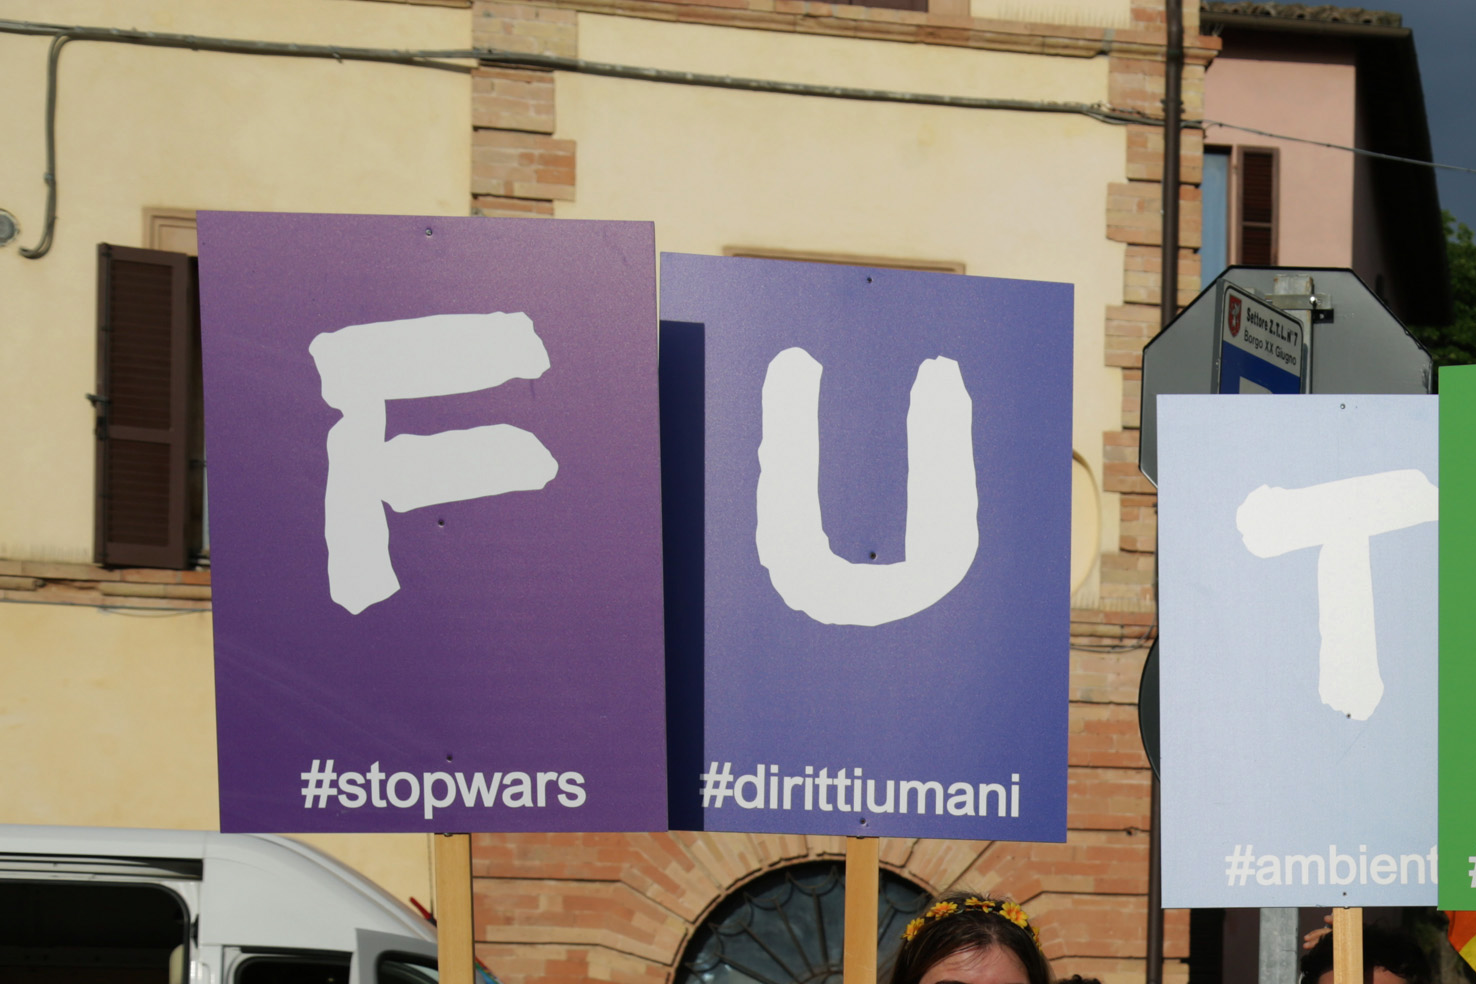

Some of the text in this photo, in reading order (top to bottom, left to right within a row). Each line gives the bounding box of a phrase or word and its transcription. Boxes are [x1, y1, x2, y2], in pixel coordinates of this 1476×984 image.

[1244, 329, 1264, 350] Borgo
[1275, 346, 1297, 366] Giugno
[1246, 307, 1268, 331] Settore
[309, 312, 559, 615] F
[755, 346, 979, 627] U
[1236, 469, 1438, 720] T
[301, 760, 587, 820] #stopwars
[702, 761, 1020, 818] #dirittiumani
